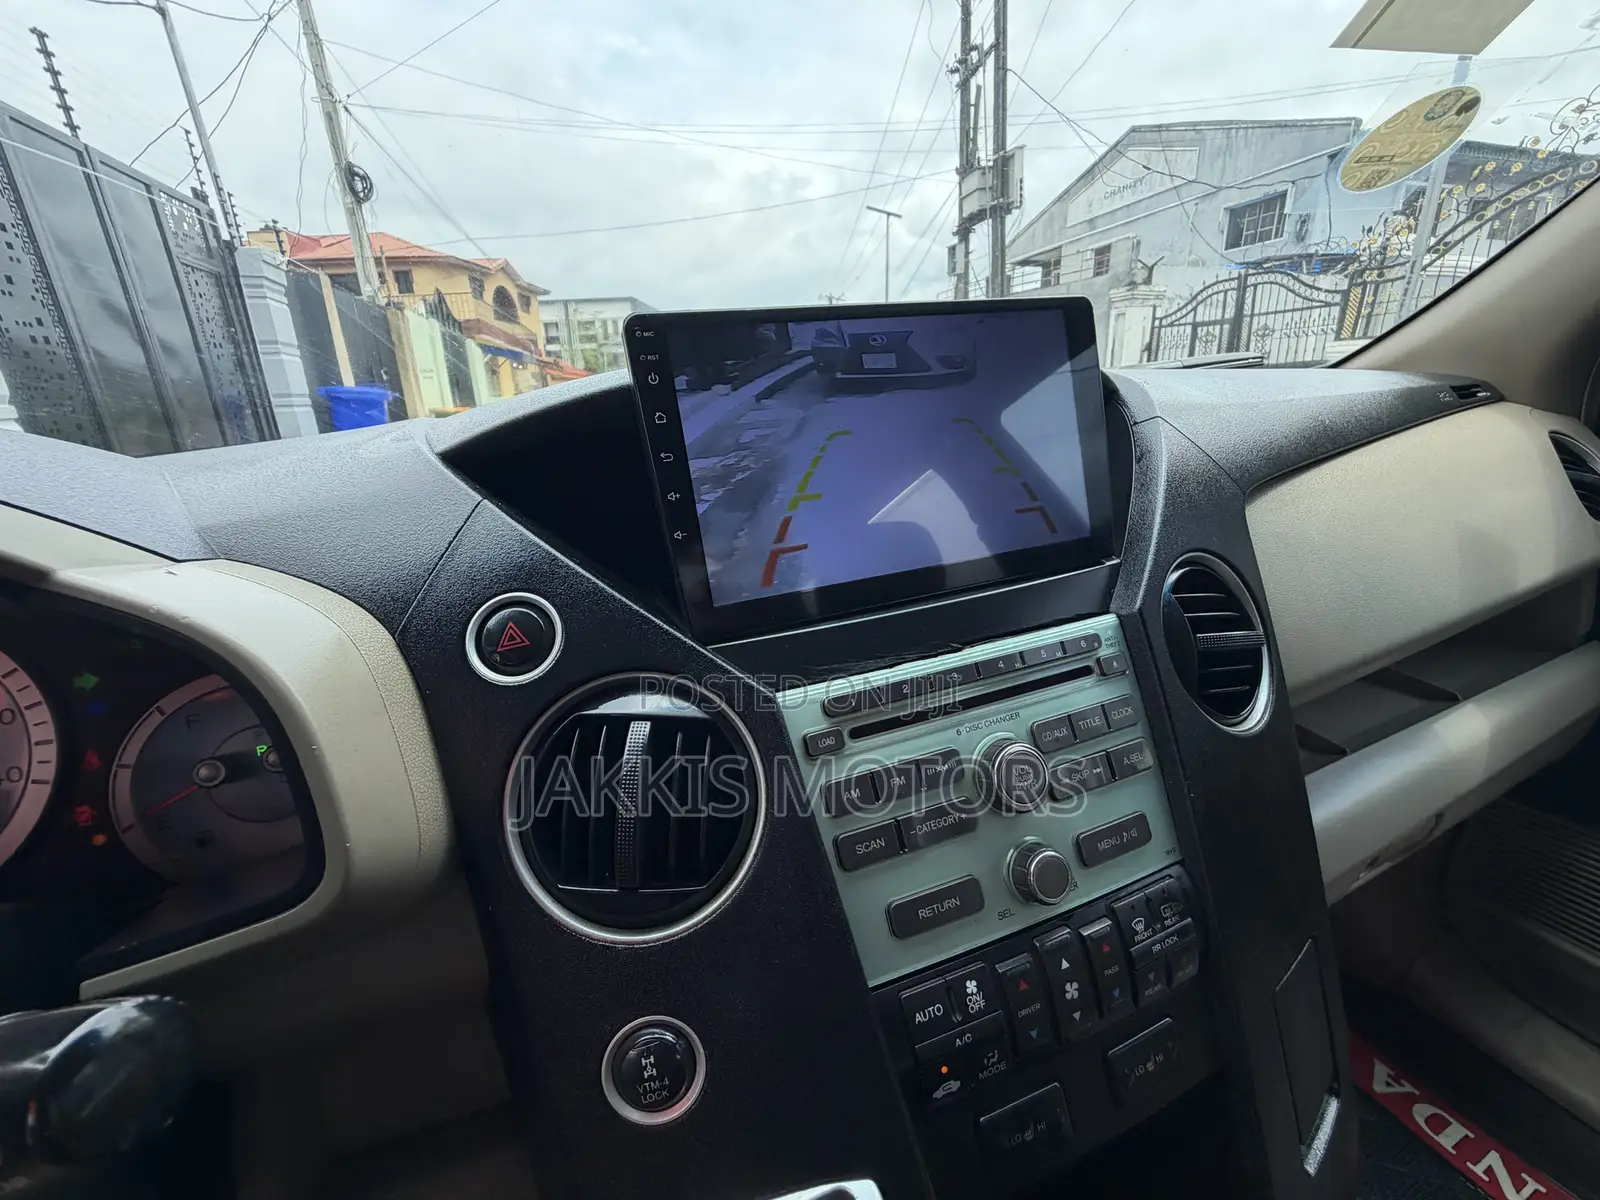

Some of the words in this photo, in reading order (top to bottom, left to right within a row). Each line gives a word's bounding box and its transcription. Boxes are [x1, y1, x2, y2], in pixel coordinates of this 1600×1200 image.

[902, 684, 909, 694] 2
[998, 660, 1004, 668] 4
[1041, 649, 1047, 658] 5
[1081, 639, 1087, 648] 6
[1111, 706, 1134, 720] CLOCK
[956, 724, 984, 736] 6-DISC
[984, 711, 1021, 728] CHANGER
[1079, 716, 1101, 730] TITLE
[1042, 726, 1069, 742] CD/AUX
[817, 736, 836, 748] LOAD
[257, 745, 268, 757] P
[1012, 764, 1033, 776] VOL
[1071, 769, 1090, 782] SKIP
[890, 775, 906, 788] FM
[1015, 779, 1038, 793] PWR
[843, 788, 861, 800] AM
[855, 837, 885, 854] SCAN
[1097, 835, 1120, 852] MENU
[917, 896, 961, 919] RETURN
[997, 908, 1016, 921] SEL
[1134, 928, 1153, 943] FRONT
[1162, 934, 1180, 949] LOCK
[1104, 964, 1120, 977] PASS
[968, 999, 986, 1014] OFF
[1018, 1002, 1041, 1018] DRIVER
[915, 1004, 944, 1025] AUTO
[955, 1033, 973, 1048] A/C
[978, 1061, 1007, 1080] MODE
[1135, 1065, 1145, 1077] LO
[1155, 1053, 1164, 1065] HI
[636, 1077, 670, 1094] VTM-4
[641, 1088, 670, 1104] LOCK
